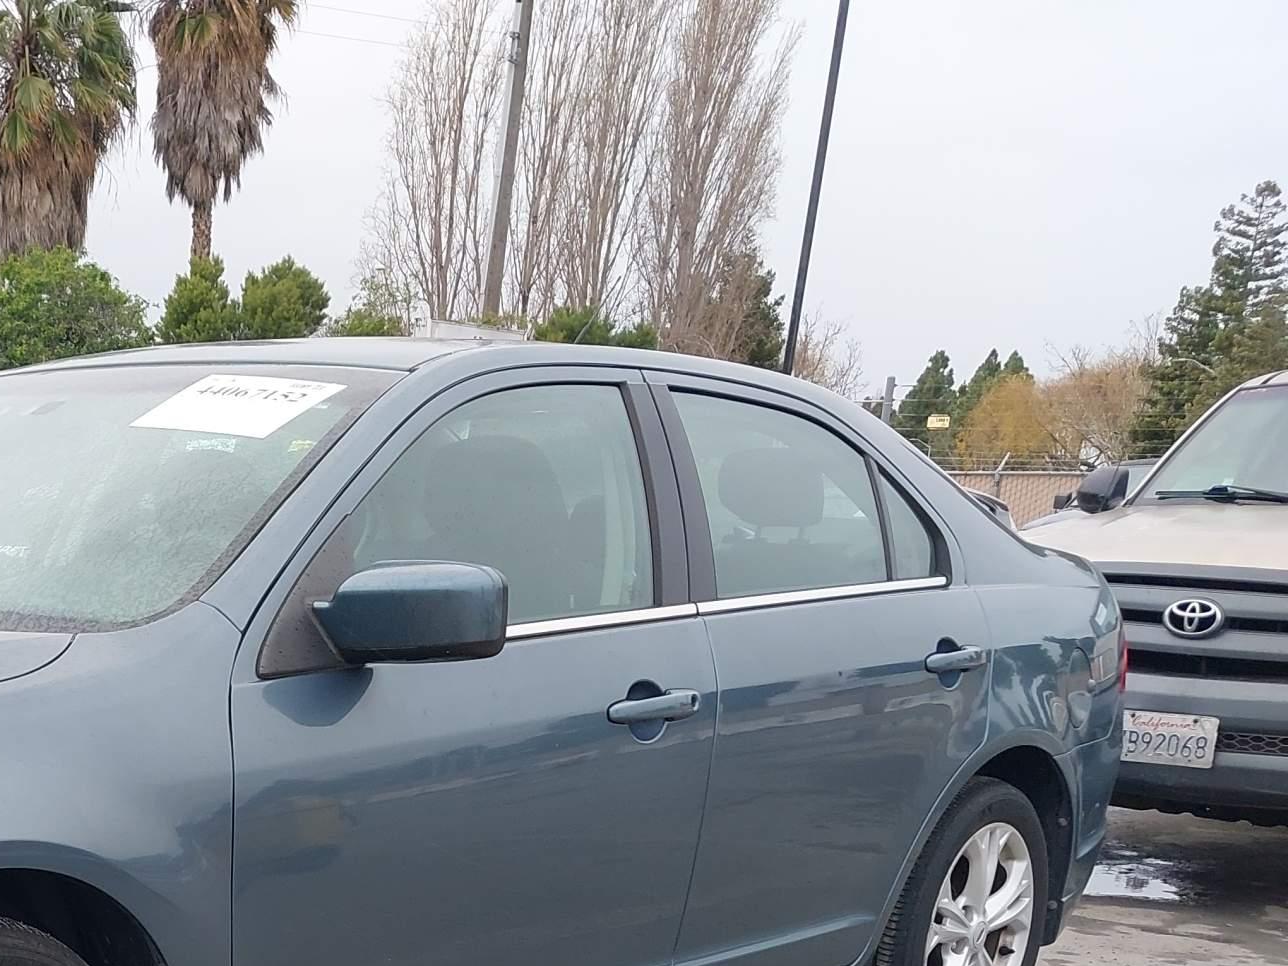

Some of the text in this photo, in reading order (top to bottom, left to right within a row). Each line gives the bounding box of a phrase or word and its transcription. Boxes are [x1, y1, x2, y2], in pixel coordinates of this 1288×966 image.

[196, 385, 308, 402] 44067152
[1131, 714, 1192, 731] California
[1123, 730, 1208, 759] B92068
